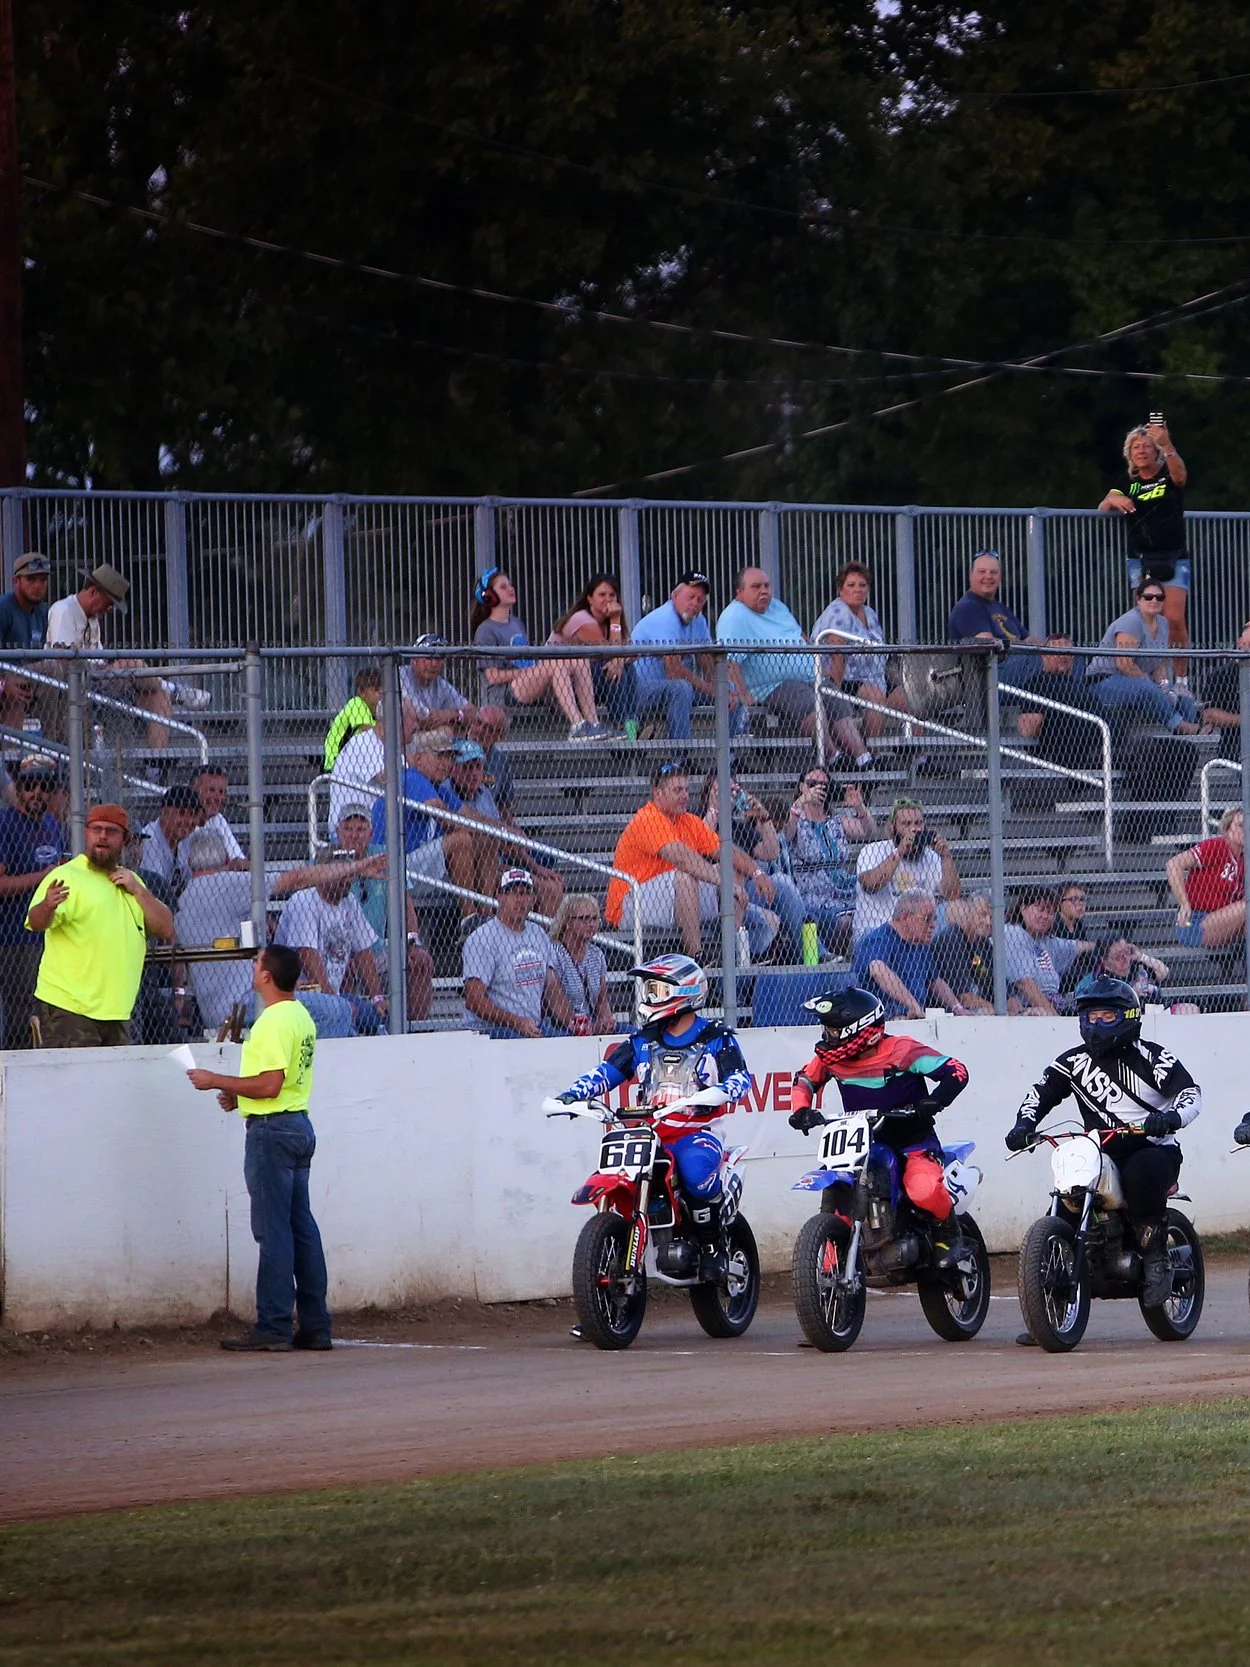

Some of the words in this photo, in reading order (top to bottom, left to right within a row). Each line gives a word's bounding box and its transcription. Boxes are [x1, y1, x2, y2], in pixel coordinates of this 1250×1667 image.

[1137, 484, 1166, 501] 46
[1066, 1052, 1124, 1106] ANSR
[1153, 1049, 1178, 1089] ANS
[600, 1141, 652, 1169] 68
[822, 1128, 865, 1158] 104
